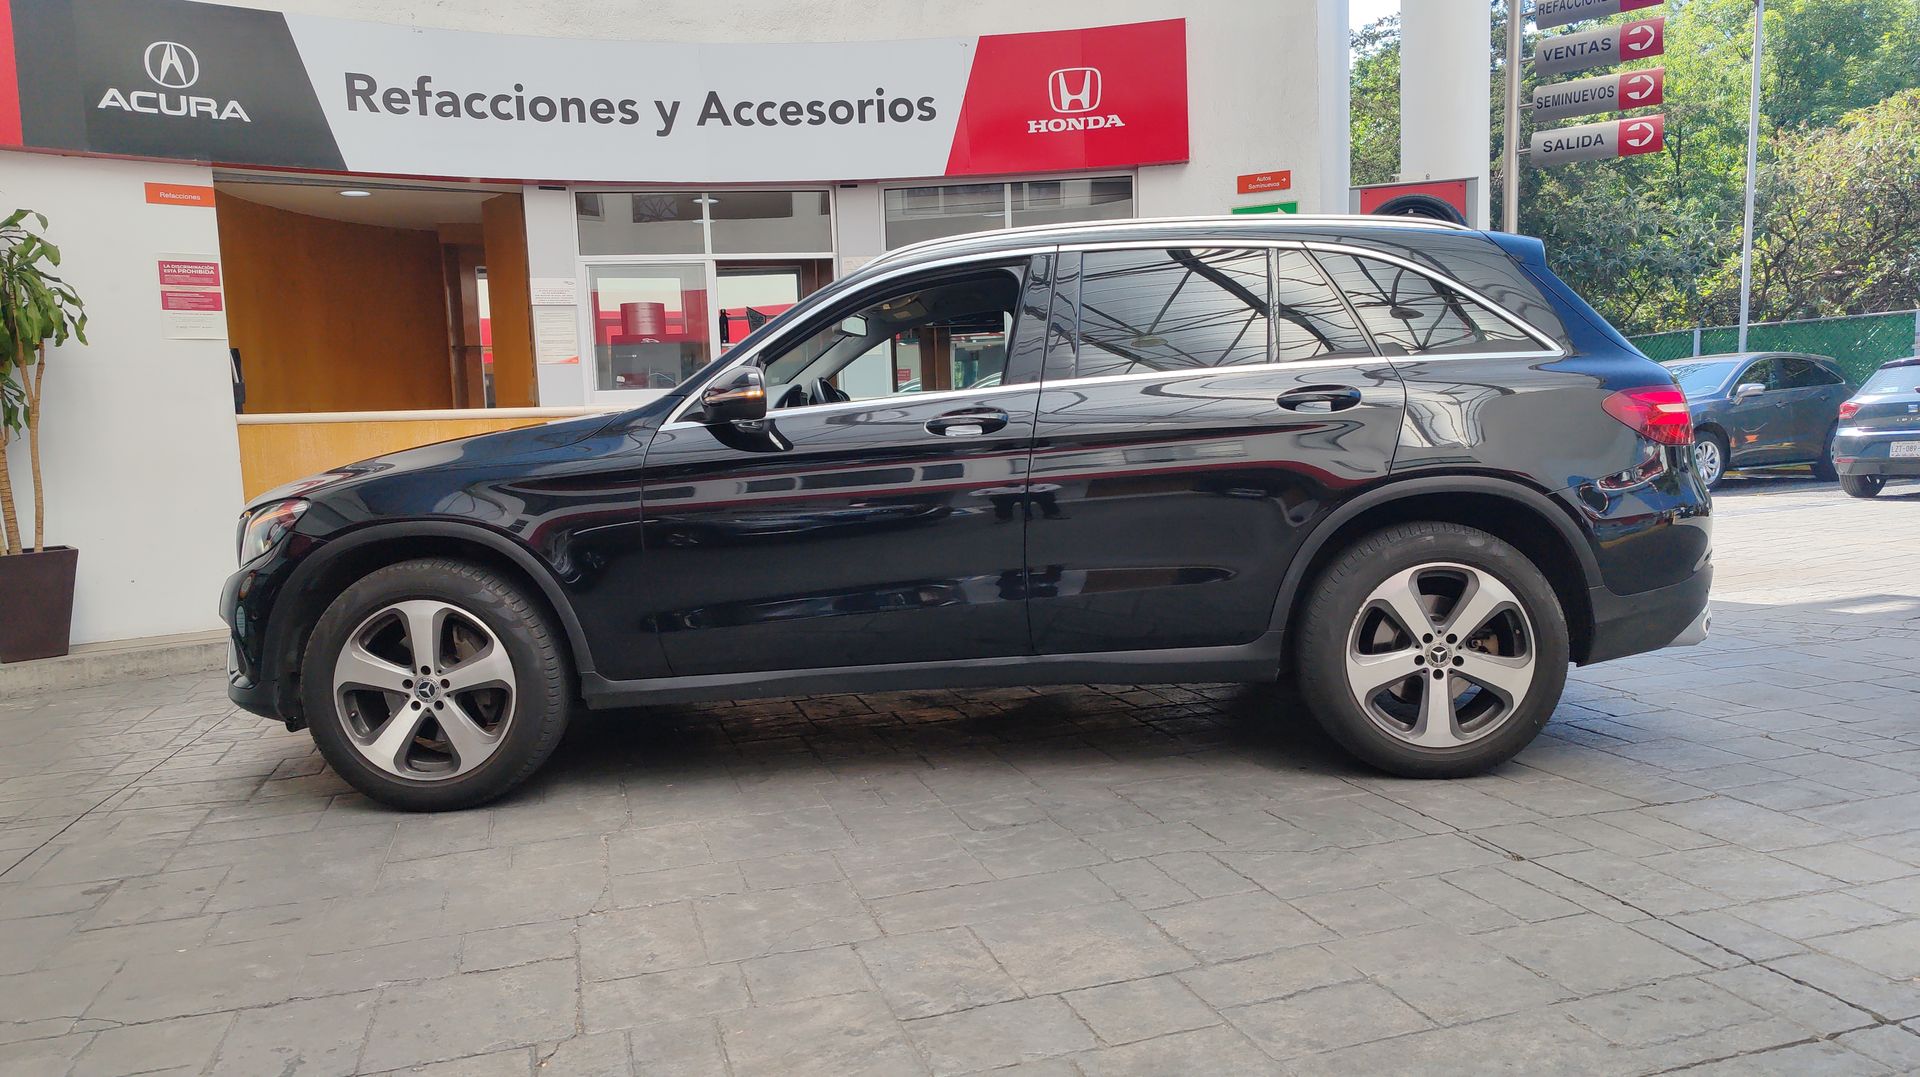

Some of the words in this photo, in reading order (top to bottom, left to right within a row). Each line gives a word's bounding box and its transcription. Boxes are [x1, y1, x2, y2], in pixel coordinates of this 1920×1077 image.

[1543, 37, 1612, 61] VENTAS
[97, 88, 251, 122] ACURA
[345, 72, 640, 125] Refacciones
[654, 100, 681, 137] y
[696, 87, 937, 127] Accesorios
[1536, 85, 1615, 110] SEMINUEVOS
[1027, 114, 1126, 133] HONDA
[1543, 133, 1605, 153] SALIDA
[159, 191, 201, 200] Refacciones
